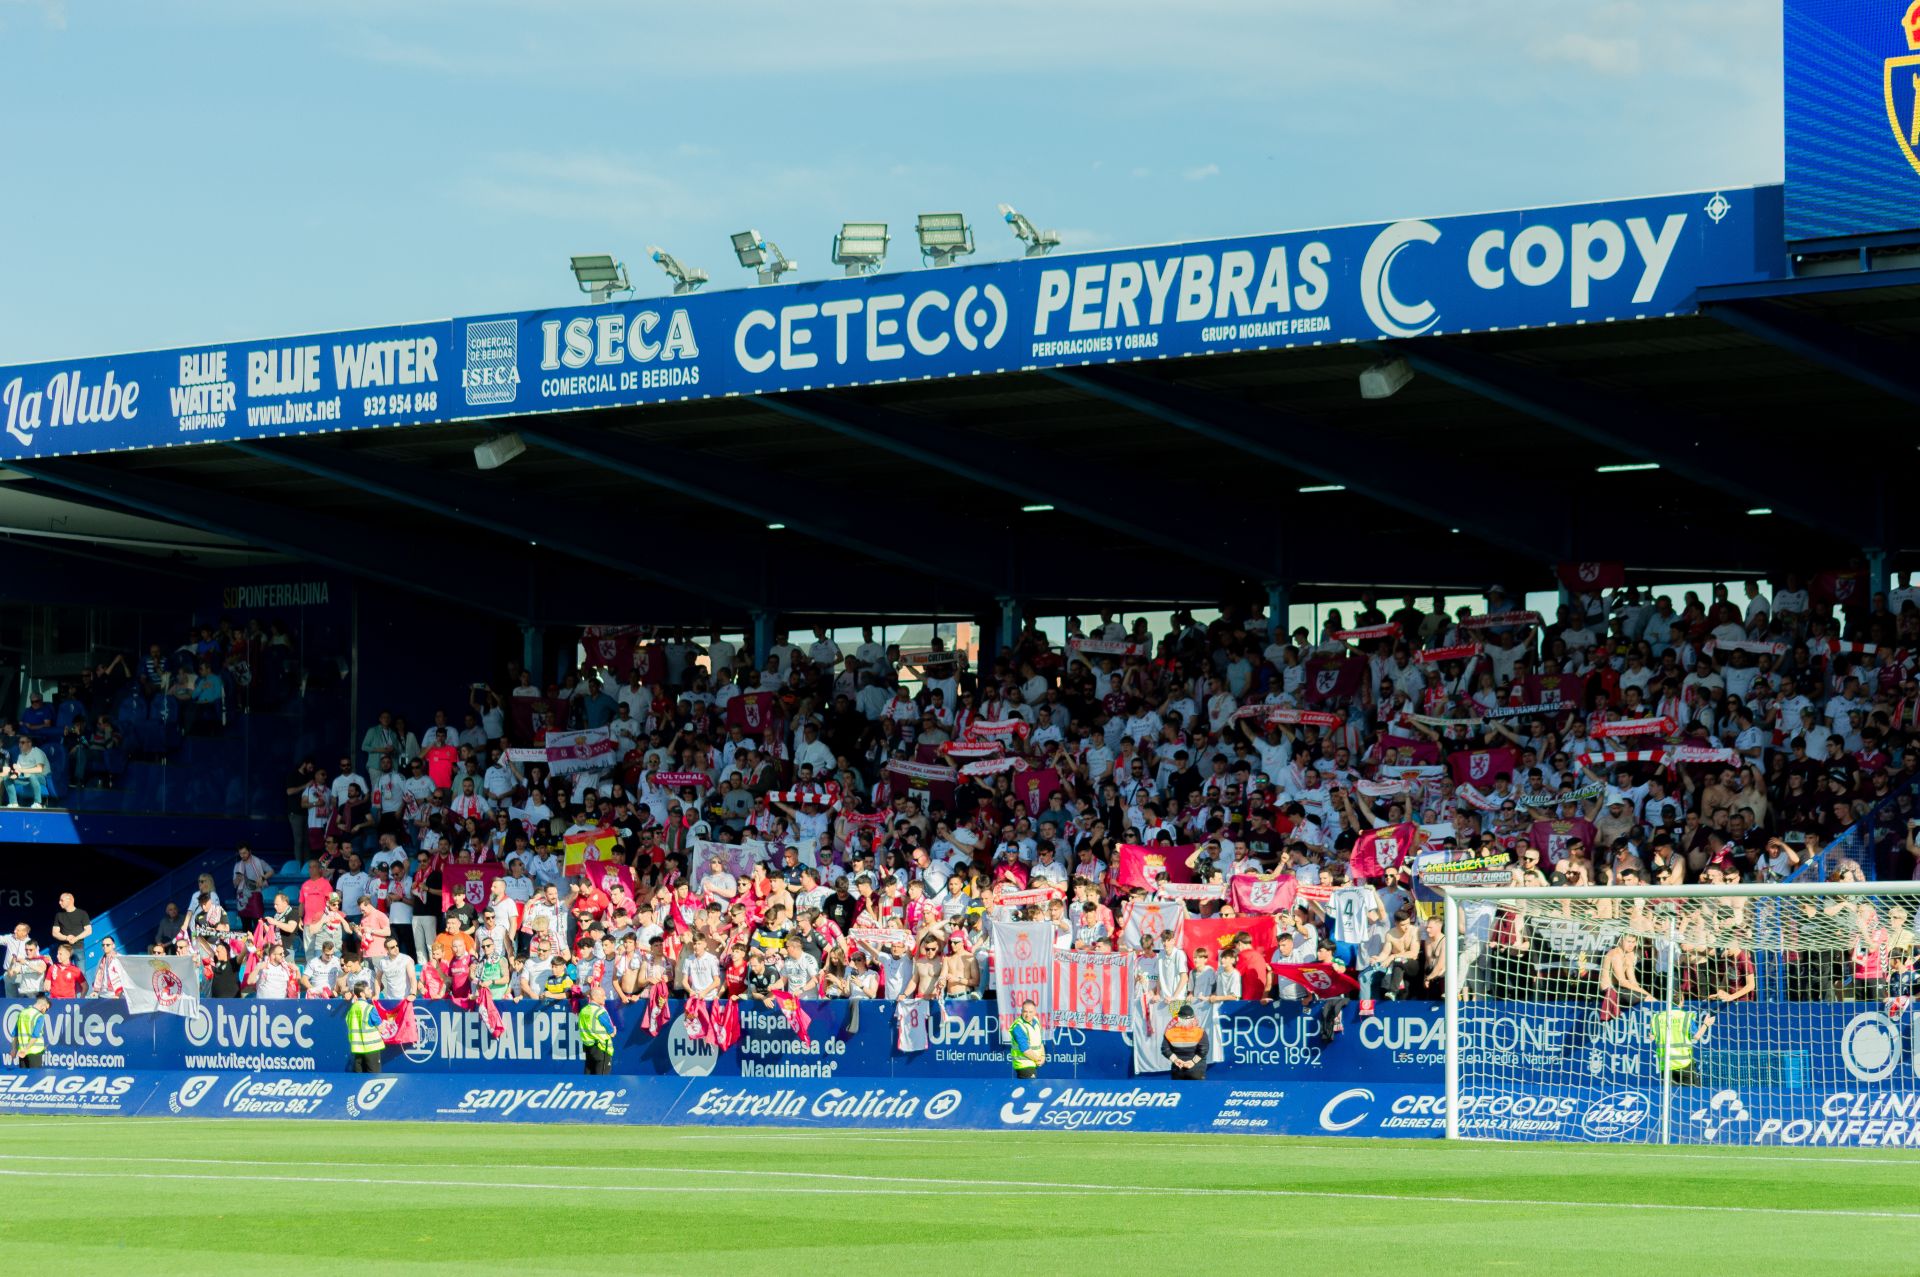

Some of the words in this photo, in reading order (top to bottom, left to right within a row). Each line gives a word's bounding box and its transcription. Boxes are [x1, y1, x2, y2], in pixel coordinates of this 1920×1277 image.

[1468, 212, 1687, 309] copy
[1033, 241, 1331, 336] PERYBRAS
[734, 283, 1008, 374] CETECO
[1201, 325, 1237, 342] GRUPO
[1239, 319, 1289, 339] MORANTE
[1290, 316, 1331, 334] PEREDA
[471, 336, 513, 349] COMERCIAL
[541, 309, 699, 370] ISECA
[1032, 336, 1113, 357] PERFORACIONES
[1115, 335, 1122, 349] Y
[1124, 332, 1159, 349] OBRAS
[470, 351, 480, 361] DE
[482, 348, 513, 360] BEBIDAS
[180, 351, 228, 386] BLUE
[247, 345, 321, 398] BLUE
[333, 337, 439, 390] WATER
[462, 366, 521, 388] ISECA
[541, 373, 616, 398] COMERCIAL
[620, 371, 638, 391] DE
[642, 366, 700, 389] BEBIDAS
[4, 376, 42, 447] La
[47, 369, 140, 428] Nube
[170, 381, 236, 417] WATER
[364, 396, 386, 417] 932
[389, 394, 412, 416] 954
[414, 391, 438, 413] 848
[178, 412, 227, 432] SHIPPING
[247, 396, 341, 428] www.bws.net
[1344, 899, 1353, 916] 4
[1002, 968, 1015, 985] EN
[1019, 963, 1047, 984] LEÓN
[44, 1003, 124, 1047] vitec
[217, 1004, 314, 1048] tvitec
[910, 1008, 918, 1028] 8
[674, 1038, 712, 1056] HJM
[741, 1035, 820, 1058] Japonesa
[825, 1036, 846, 1056] de
[936, 1050, 945, 1061] El
[946, 1049, 965, 1061] líder
[967, 1050, 1005, 1062] mundial
[1053, 1052, 1086, 1063] natural
[1234, 1046, 1280, 1065] Since
[1284, 1046, 1322, 1065] 1892
[185, 1053, 315, 1073] www.tvitecglass.com
[1392, 1051, 1413, 1064] Los
[1467, 1054, 1481, 1064] en
[1485, 1051, 1519, 1065] Piedra
[1522, 1053, 1563, 1065] Natural
[1611, 1054, 1640, 1074] FM
[66, 1094, 87, 1103] A.T.
[248, 1079, 333, 1097] esRadio
[1051, 1088, 1182, 1108] Almudena
[1230, 1090, 1284, 1098] PONFERRADA
[169, 1091, 182, 1114] BIERZO
[233, 1098, 284, 1113] Bierzo
[284, 1099, 323, 1114] 98.7
[346, 1095, 361, 1118] BIERZO
[687, 1087, 808, 1117] Estrella
[811, 1088, 921, 1118] Galicia
[1218, 1109, 1241, 1117] LEÓN
[1224, 1099, 1242, 1107] 987
[1242, 1099, 1261, 1107] 409
[1040, 1109, 1136, 1130] seguros
[1212, 1118, 1229, 1126] 987
[1231, 1118, 1248, 1126] 409
[1380, 1115, 1430, 1128] LÍDERES
[1458, 1118, 1499, 1129] ALSAS
[1499, 1119, 1509, 1130] A
[1510, 1120, 1561, 1131] MEDIDA
[1586, 1104, 1644, 1123] ibsa
